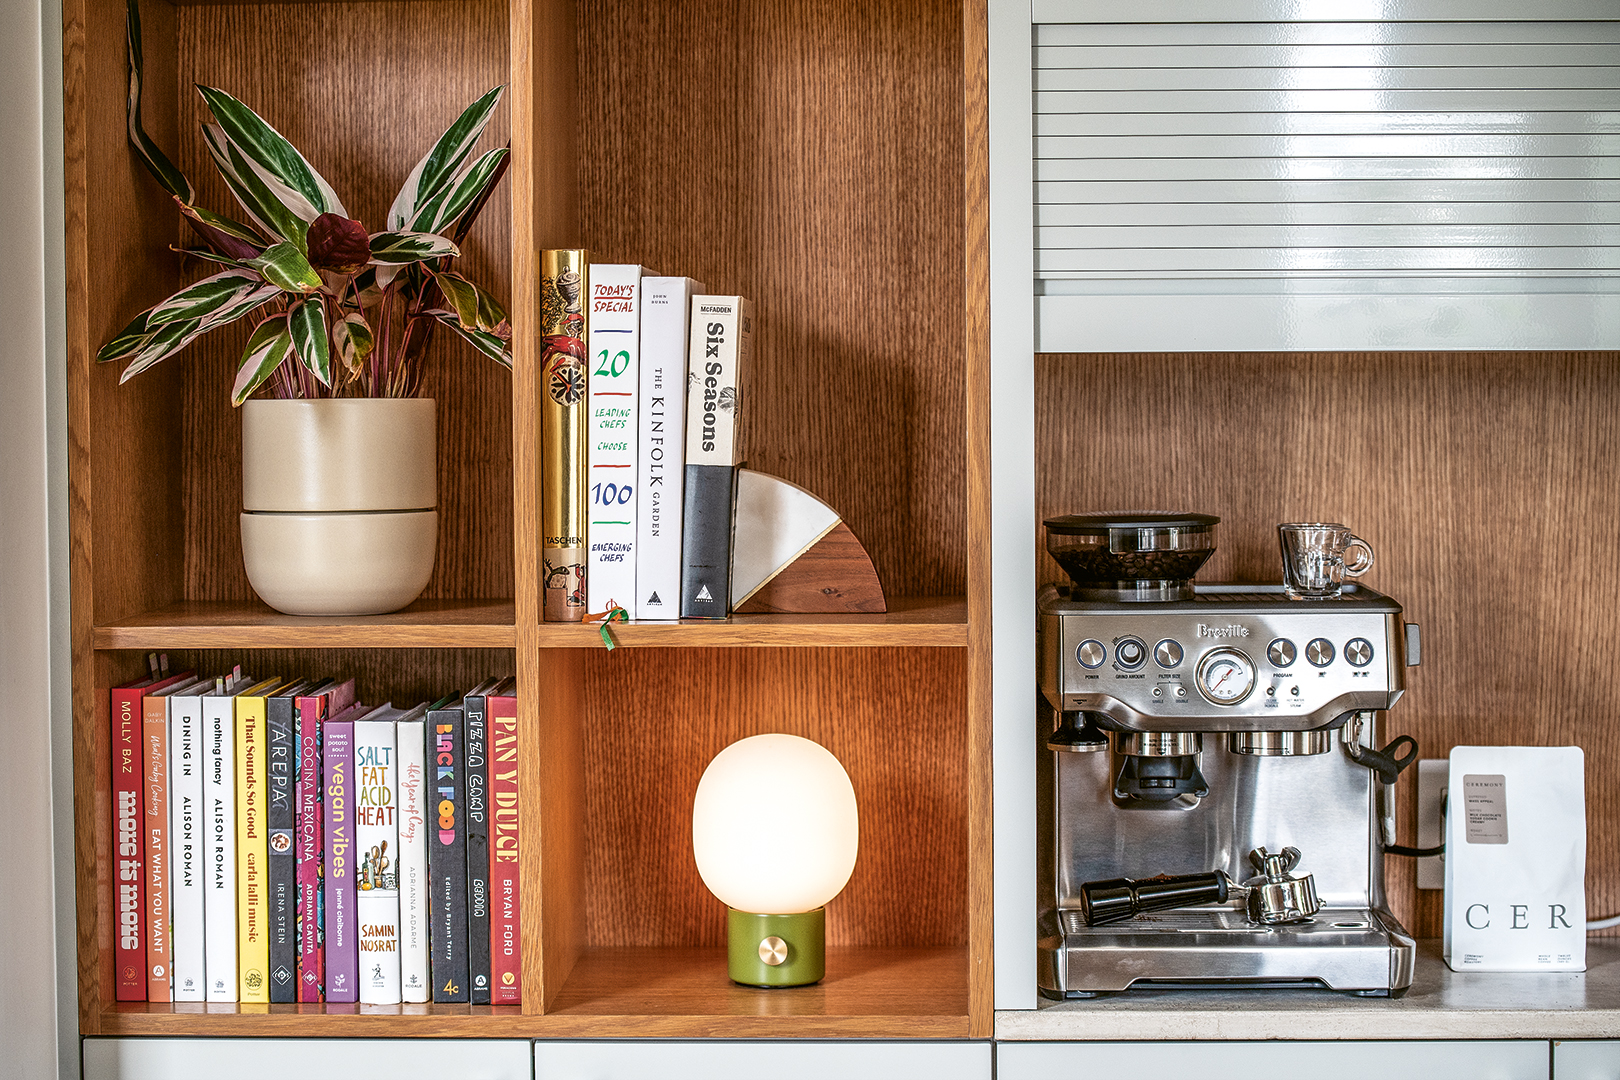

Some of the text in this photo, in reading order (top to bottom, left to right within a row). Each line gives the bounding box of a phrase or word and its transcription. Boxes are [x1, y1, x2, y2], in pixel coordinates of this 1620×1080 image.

[594, 284, 634, 296] TODAY'S
[594, 301, 634, 312] SPECIAL
[594, 349, 630, 378] 20
[702, 322, 724, 452] Six Seasons
[595, 408, 631, 417] LEADING
[599, 420, 626, 429] CHEFS
[597, 442, 628, 451] CHOOSE
[650, 397, 664, 487] KINFOLK
[591, 482, 633, 506] 100
[652, 492, 660, 537] GARDEN
[592, 543, 632, 552] EMERGING
[599, 553, 624, 562] CHEFS
[1197, 624, 1249, 638] Breville
[121, 701, 132, 773] MOLLY BAZ
[182, 716, 192, 776] DINING IN
[212, 717, 223, 785] nothing fancy
[357, 746, 392, 766] SALT
[147, 736, 164, 816] What's Gaby Cooking
[245, 715, 257, 839] That Sounds So Good
[272, 729, 287, 802] AREPA
[362, 767, 388, 786] FAT
[436, 724, 455, 845] BLACK FOOD
[468, 711, 484, 823] PIZZA CAMP
[303, 736, 314, 861] COCINA MEXICANA
[360, 786, 391, 806] ACID
[400, 762, 423, 843] the Year of Cozy
[495, 717, 518, 863] PAN Y DULCE
[215, 799, 223, 842] ALISON
[328, 762, 349, 878] vegan vibes
[358, 806, 395, 826] HEAT
[183, 797, 193, 887] ALISON ROMAN
[119, 791, 141, 950] more is more
[152, 829, 162, 953] EAT WHAT YOU WANT
[247, 853, 259, 943] carla lalli music
[335, 888, 344, 909] jenné
[445, 903, 451, 911] by
[474, 879, 485, 917] BEDDIA
[503, 879, 513, 955] BRYAN FORD
[361, 924, 394, 937] SAMIN
[361, 940, 397, 952] NOSRAT
